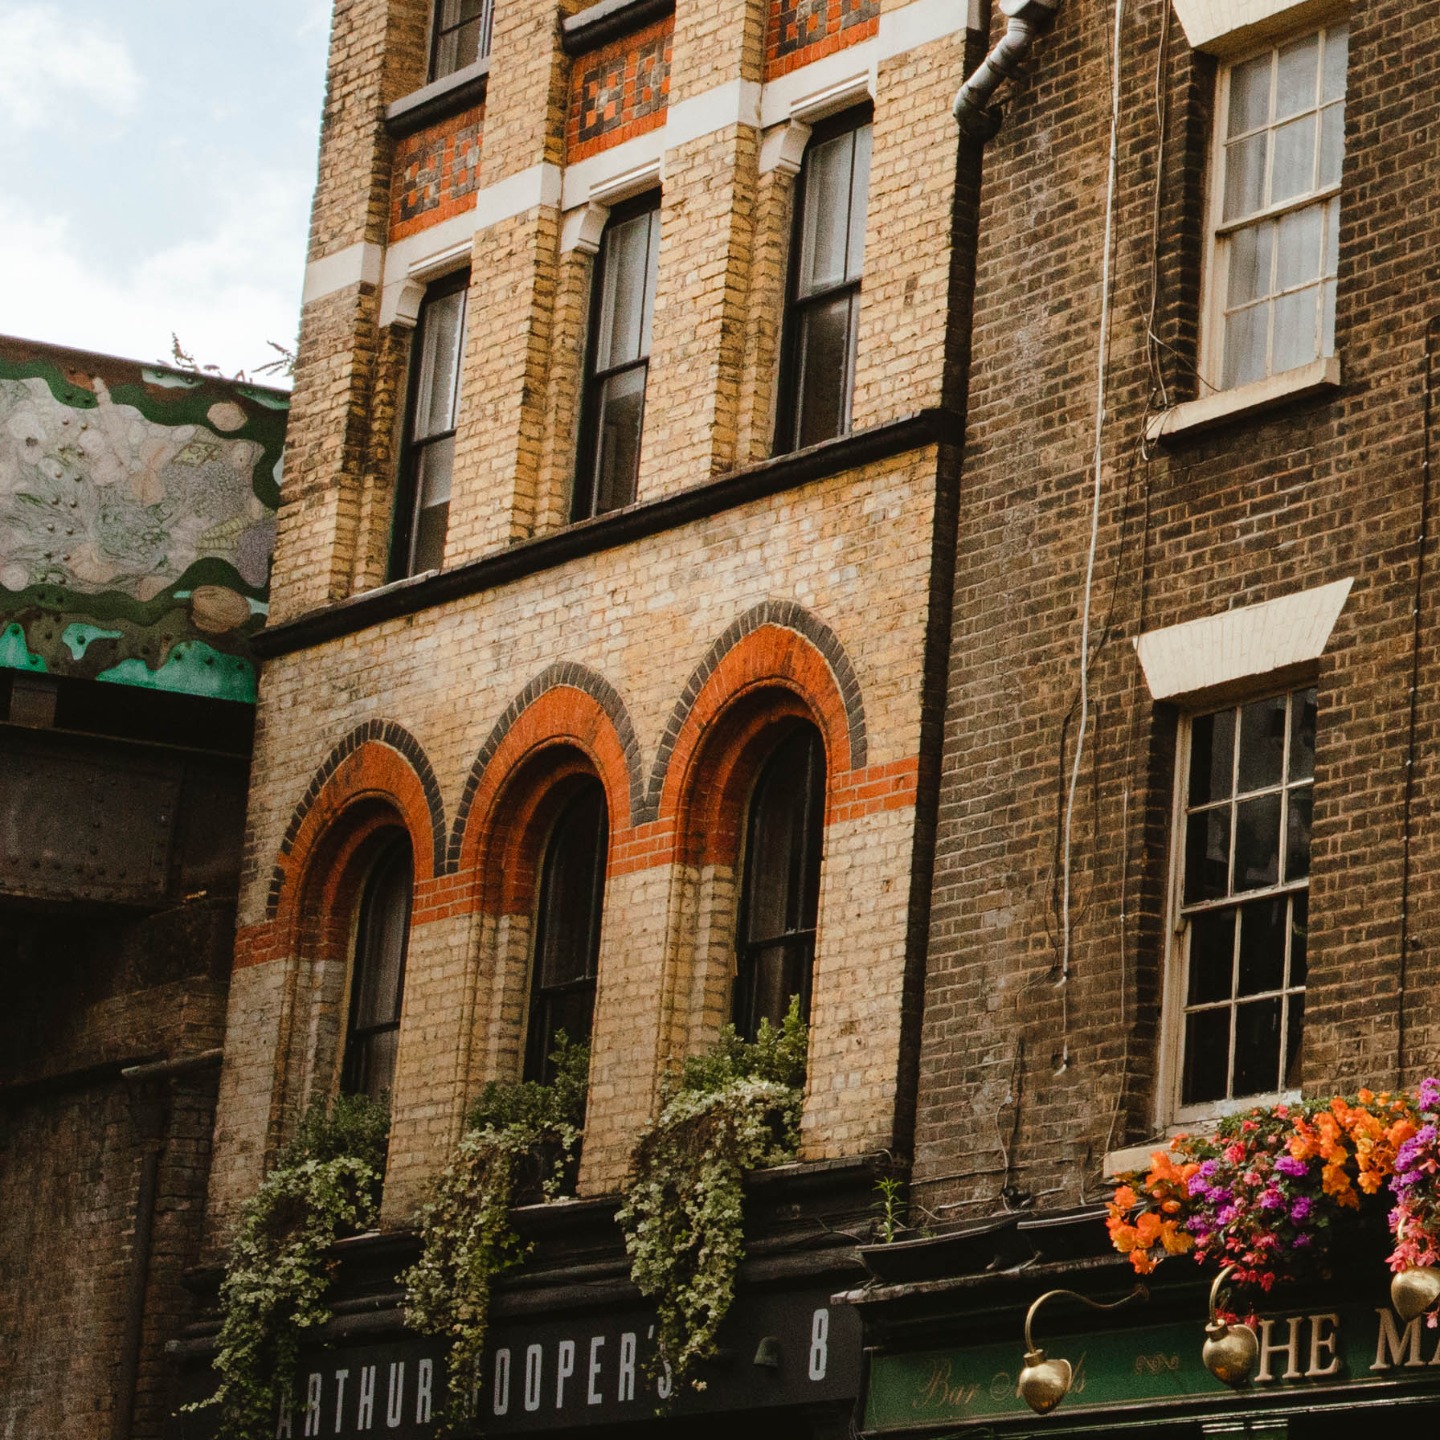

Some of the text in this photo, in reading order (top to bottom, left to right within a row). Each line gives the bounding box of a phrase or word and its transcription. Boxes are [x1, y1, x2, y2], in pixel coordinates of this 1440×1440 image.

[463, 1325, 672, 1420] OOPER'S
[808, 1307, 830, 1381] 8
[1254, 1312, 1341, 1382] HE
[912, 1357, 980, 1409] Bar
